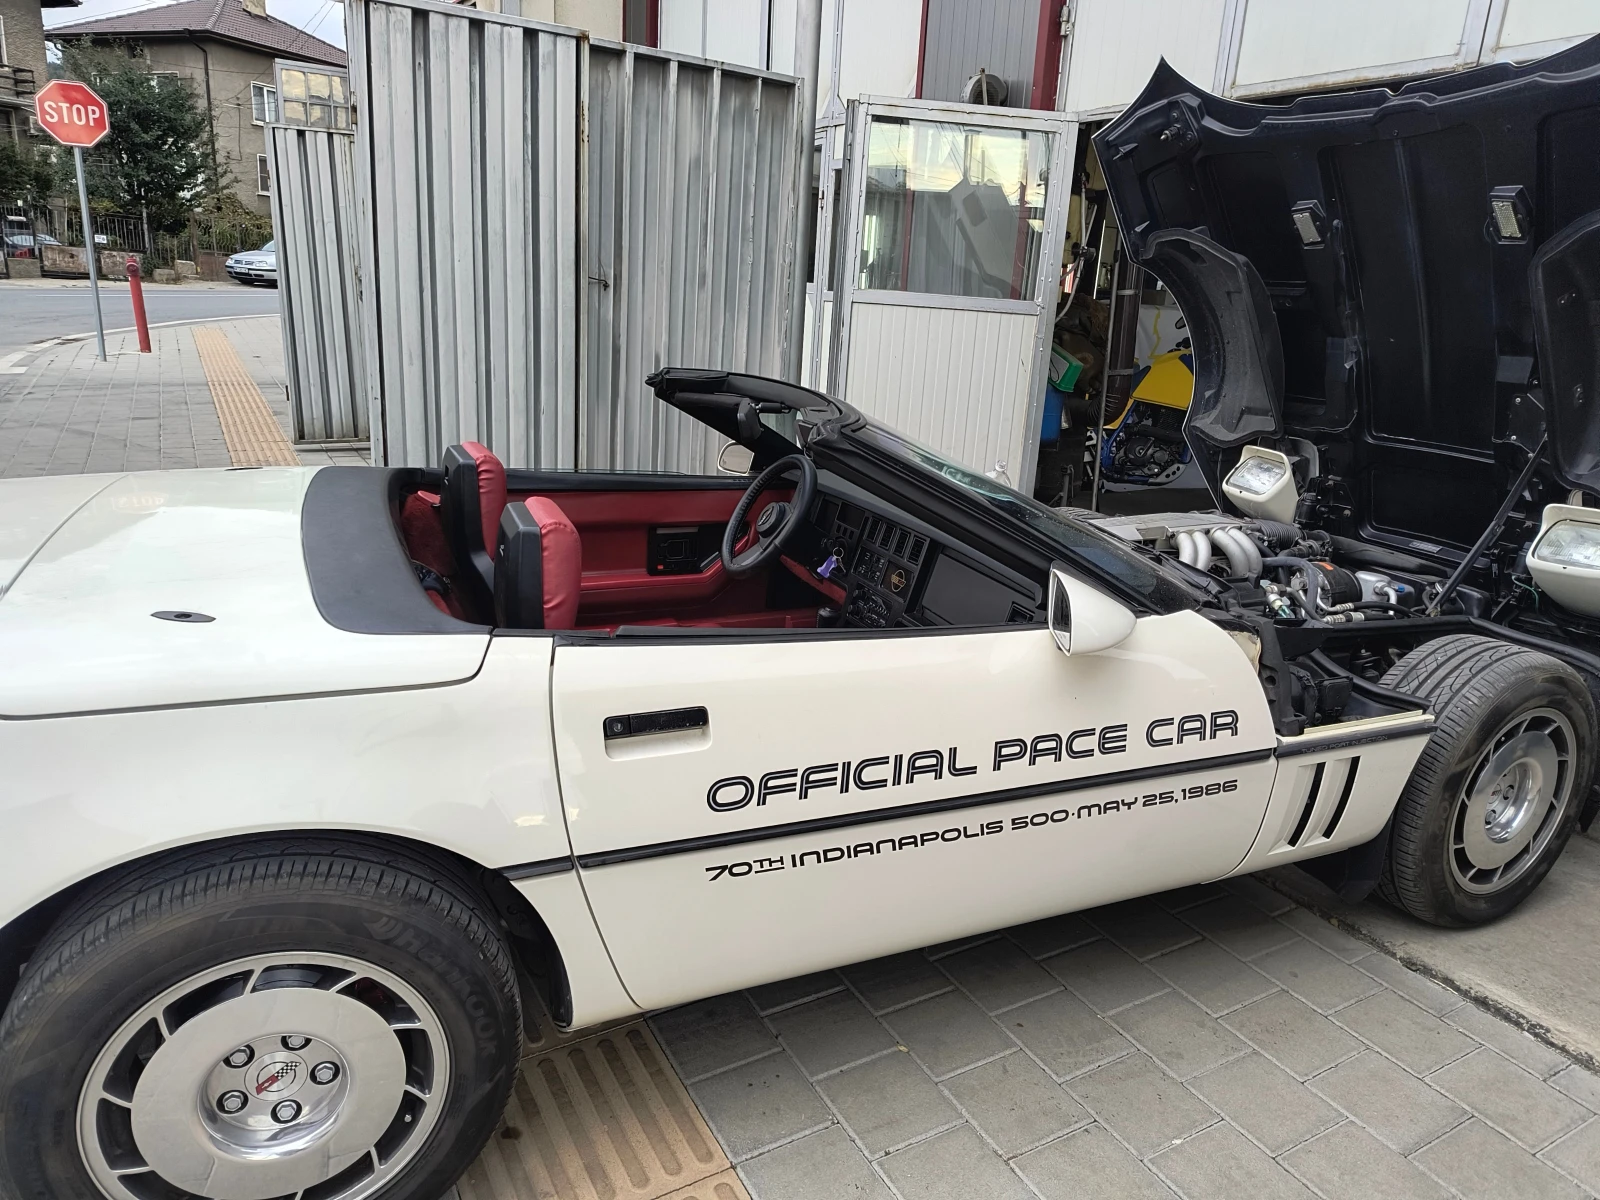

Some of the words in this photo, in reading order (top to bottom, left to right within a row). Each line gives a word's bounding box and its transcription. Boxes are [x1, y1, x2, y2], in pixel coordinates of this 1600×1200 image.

[43, 101, 100, 127] STOP
[706, 746, 978, 813] OFFICIAL
[992, 723, 1128, 772] PACE
[1145, 709, 1239, 748] CAR
[1329, 741, 1350, 750] PORT
[705, 855, 785, 882] 70TH
[790, 820, 1004, 868] INDIANAPOLIS
